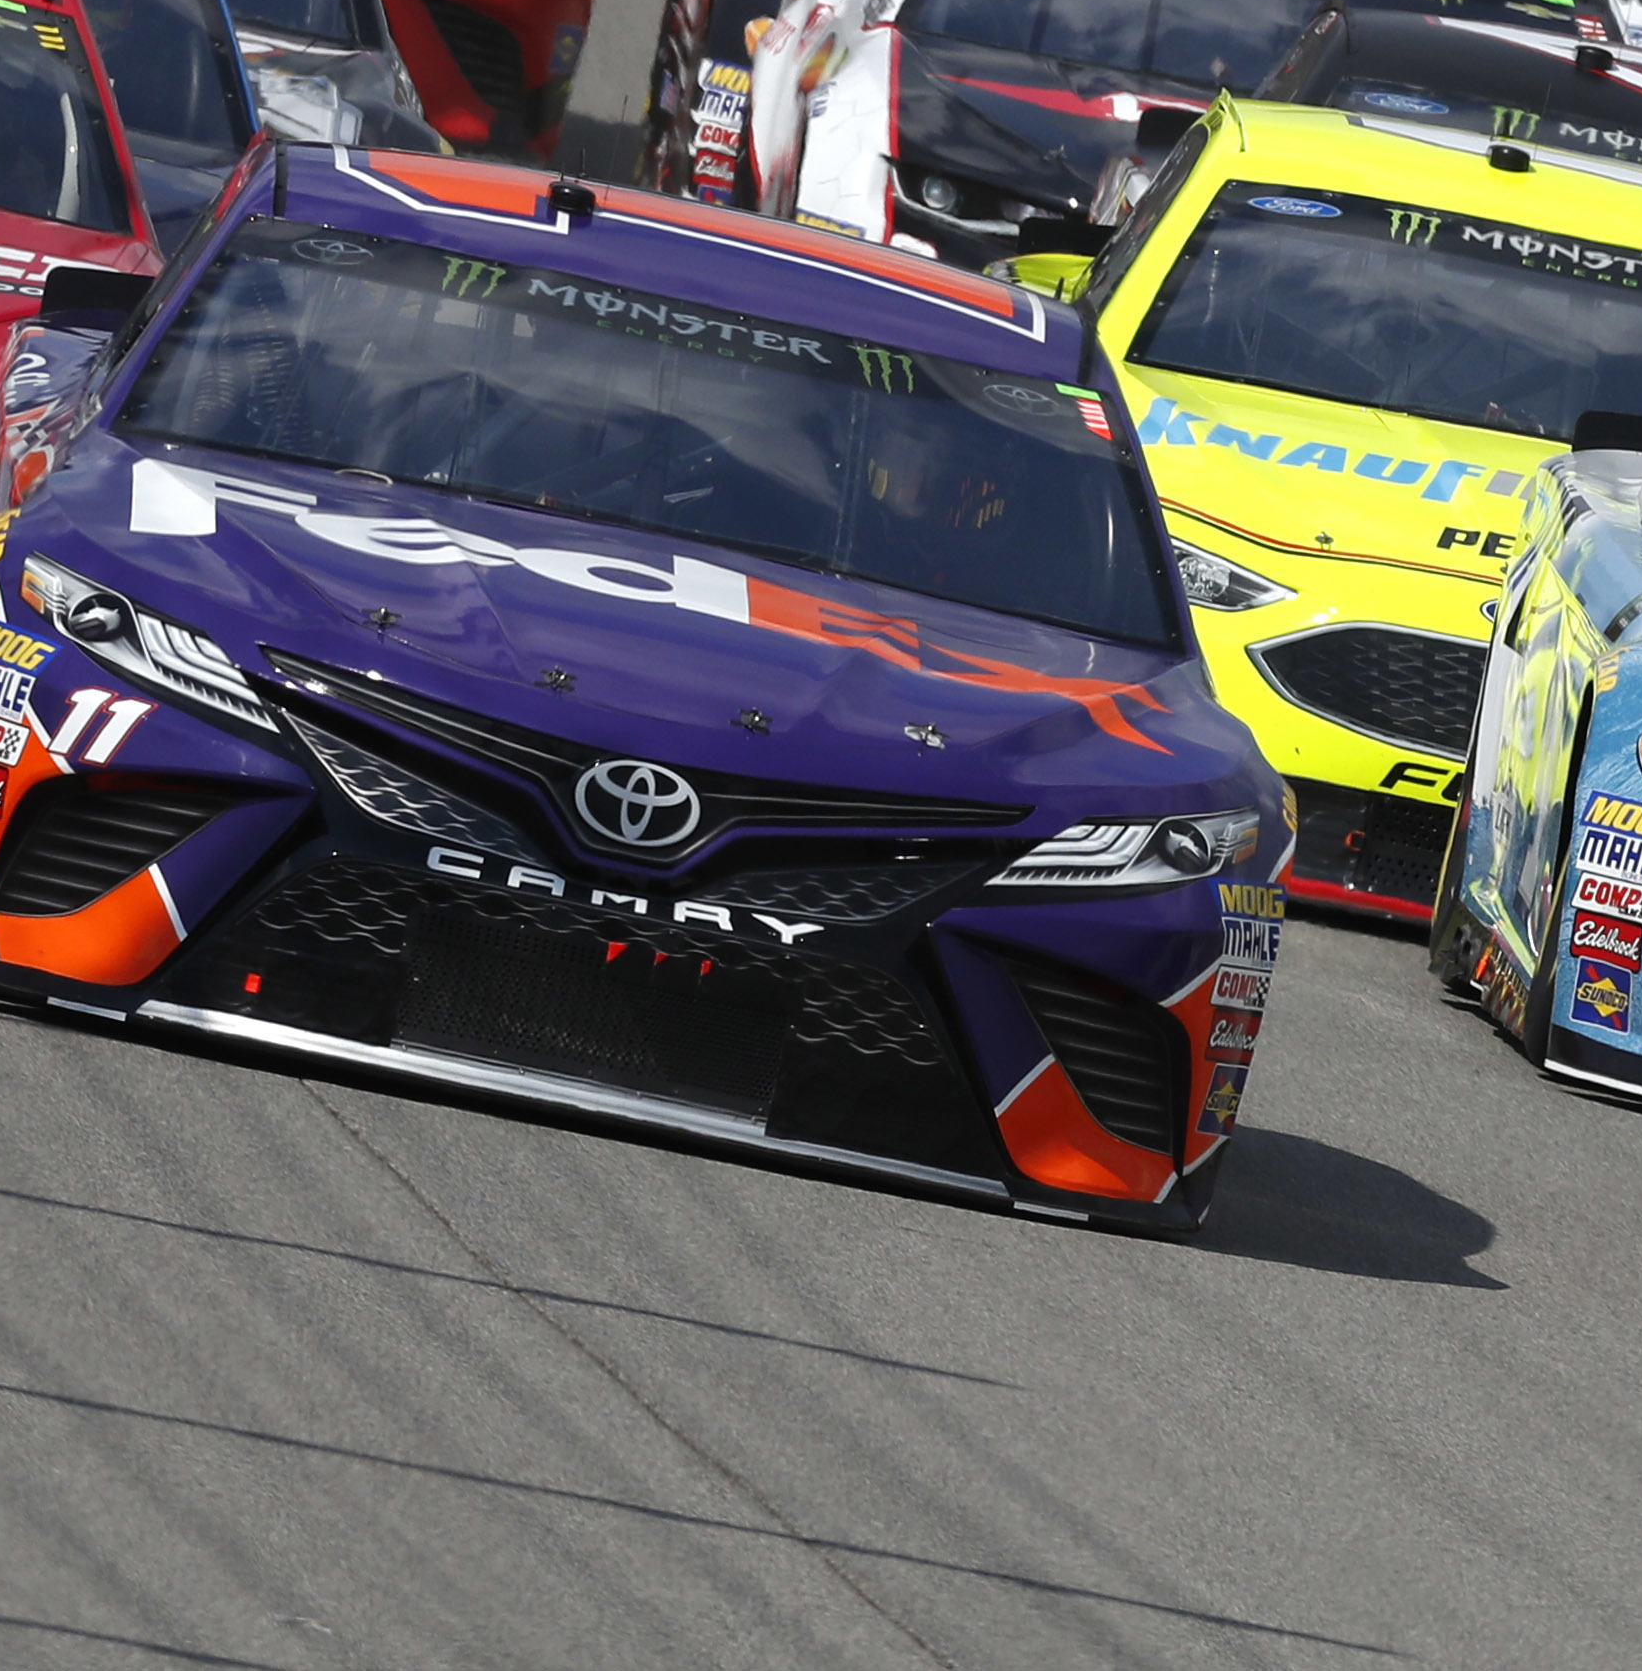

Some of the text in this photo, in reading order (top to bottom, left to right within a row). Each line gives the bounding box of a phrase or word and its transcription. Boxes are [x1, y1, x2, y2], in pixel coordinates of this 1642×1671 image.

[527, 277, 833, 366] MONSTER
[595, 319, 765, 365] ENERGY
[130, 458, 1175, 756] FedEx
[48, 685, 158, 768] 11
[426, 844, 826, 947] CAMRY
[1218, 883, 1286, 918] MOOG
[1578, 878, 1642, 909] COMP
[1225, 918, 1281, 961] MAHLE
[1572, 920, 1641, 959] Edelbrock
[1216, 971, 1258, 999] COMP
[1577, 981, 1629, 1012] SUNOCO
